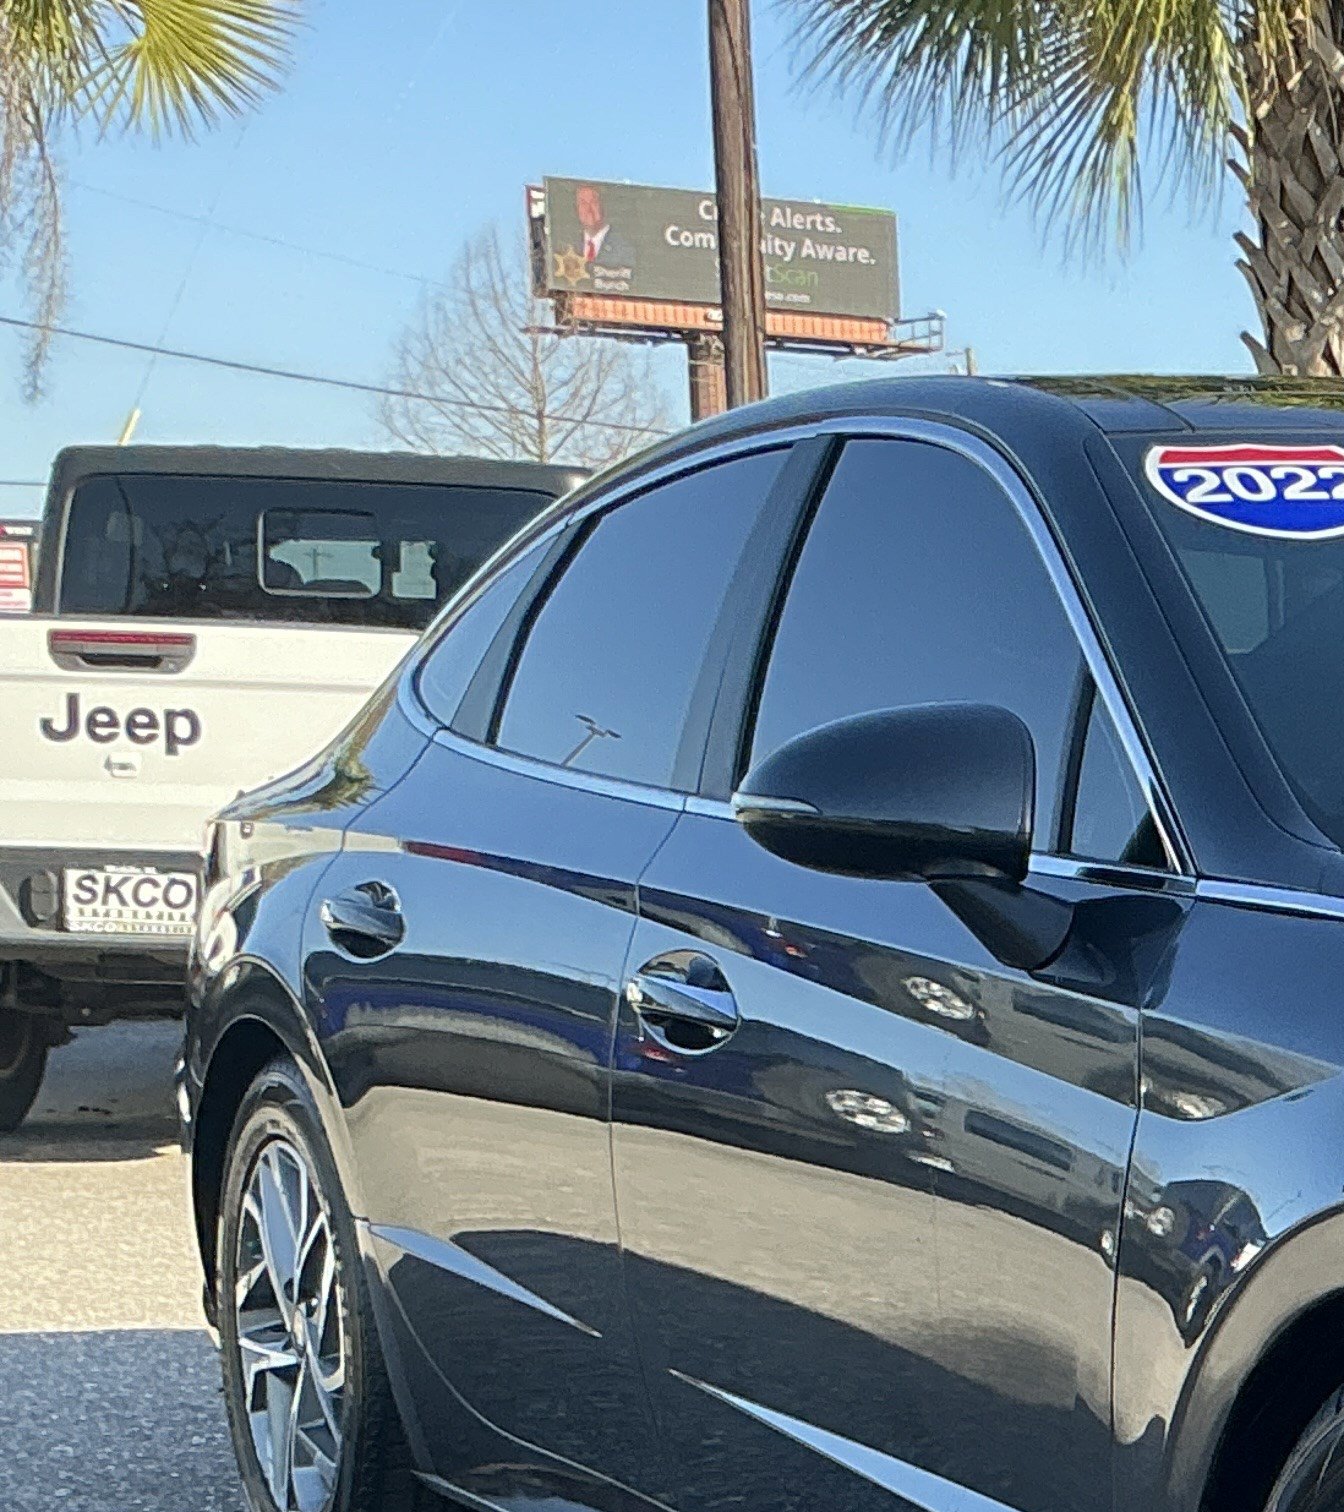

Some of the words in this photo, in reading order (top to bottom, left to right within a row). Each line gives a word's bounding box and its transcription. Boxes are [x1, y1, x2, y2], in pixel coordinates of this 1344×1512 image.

[770, 206, 843, 233] Alerts.
[664, 224, 796, 262] Comity
[801, 238, 876, 265] Aware.
[39, 692, 202, 756] Jeep
[72, 873, 193, 909] SKCO
